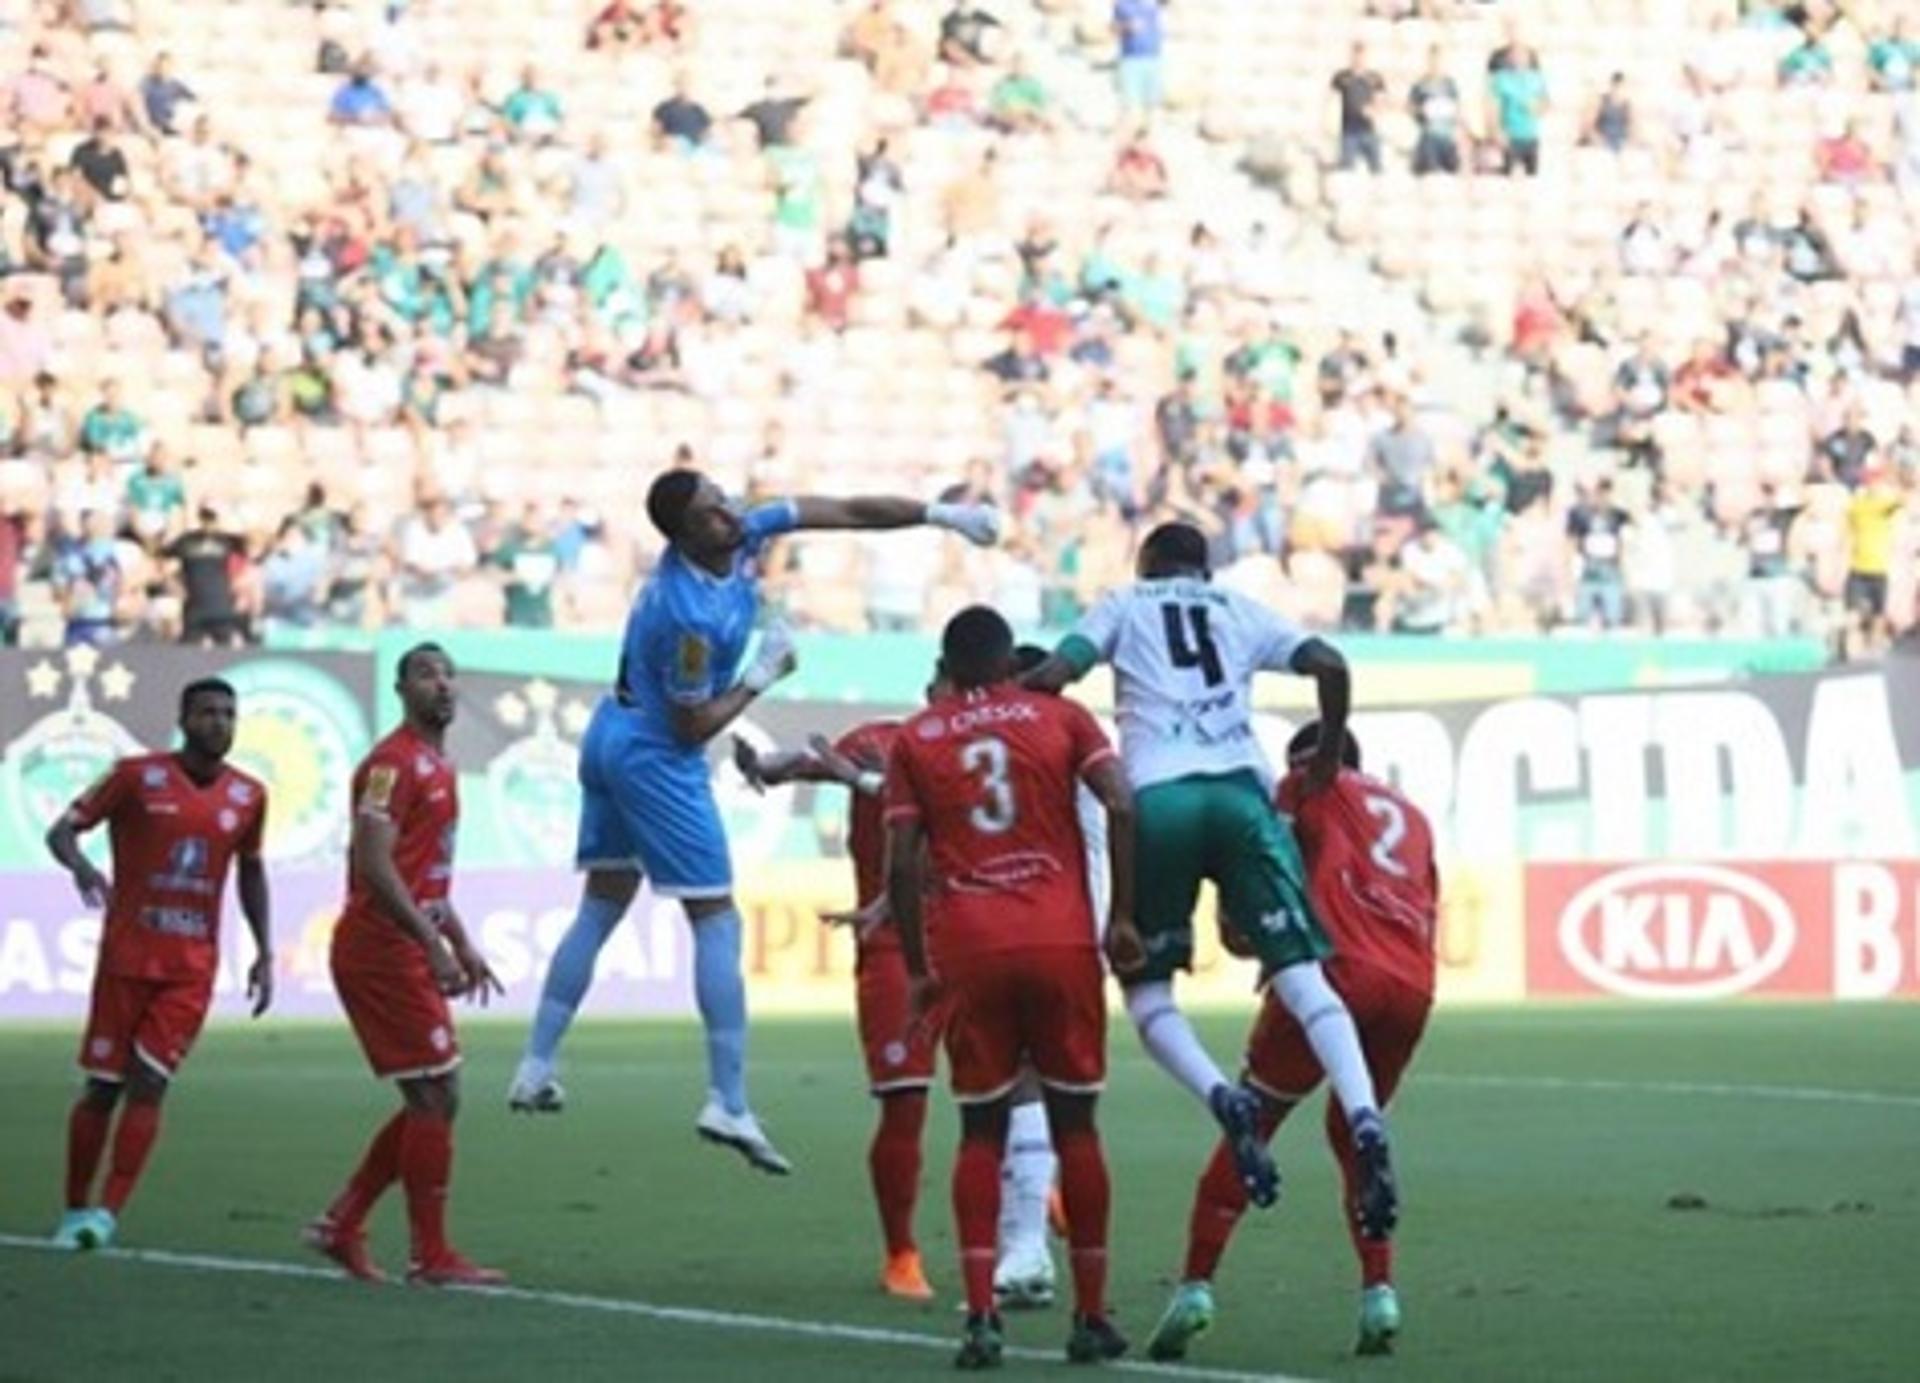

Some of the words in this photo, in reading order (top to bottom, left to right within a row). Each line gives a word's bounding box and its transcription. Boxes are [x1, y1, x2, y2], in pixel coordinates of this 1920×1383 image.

[1160, 600, 1225, 688] 4
[961, 736, 1014, 834] 3
[1364, 796, 1409, 877] 2
[1600, 893, 1757, 972] KIA
